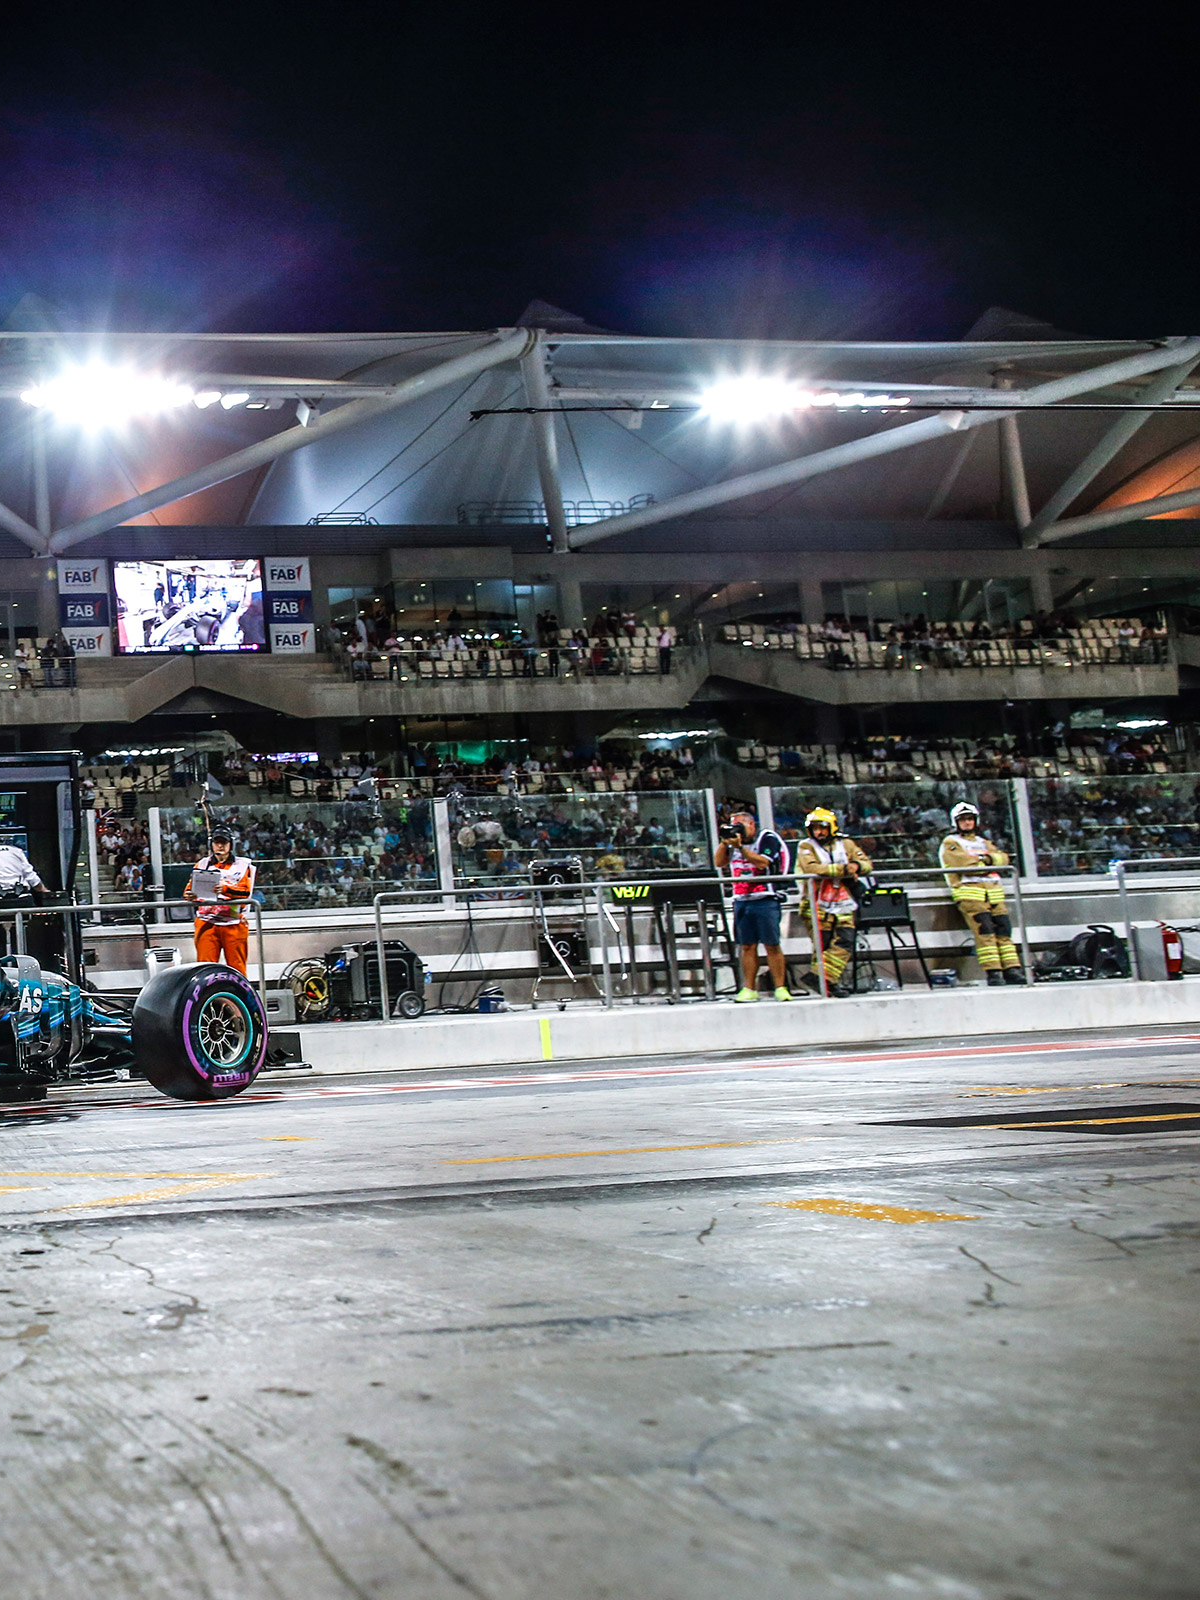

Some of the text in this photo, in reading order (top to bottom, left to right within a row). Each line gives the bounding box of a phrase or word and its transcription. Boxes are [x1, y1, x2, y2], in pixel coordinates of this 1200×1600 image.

[192, 971, 252, 1002] P ZERO
[212, 1071, 250, 1087] PIRELLI
